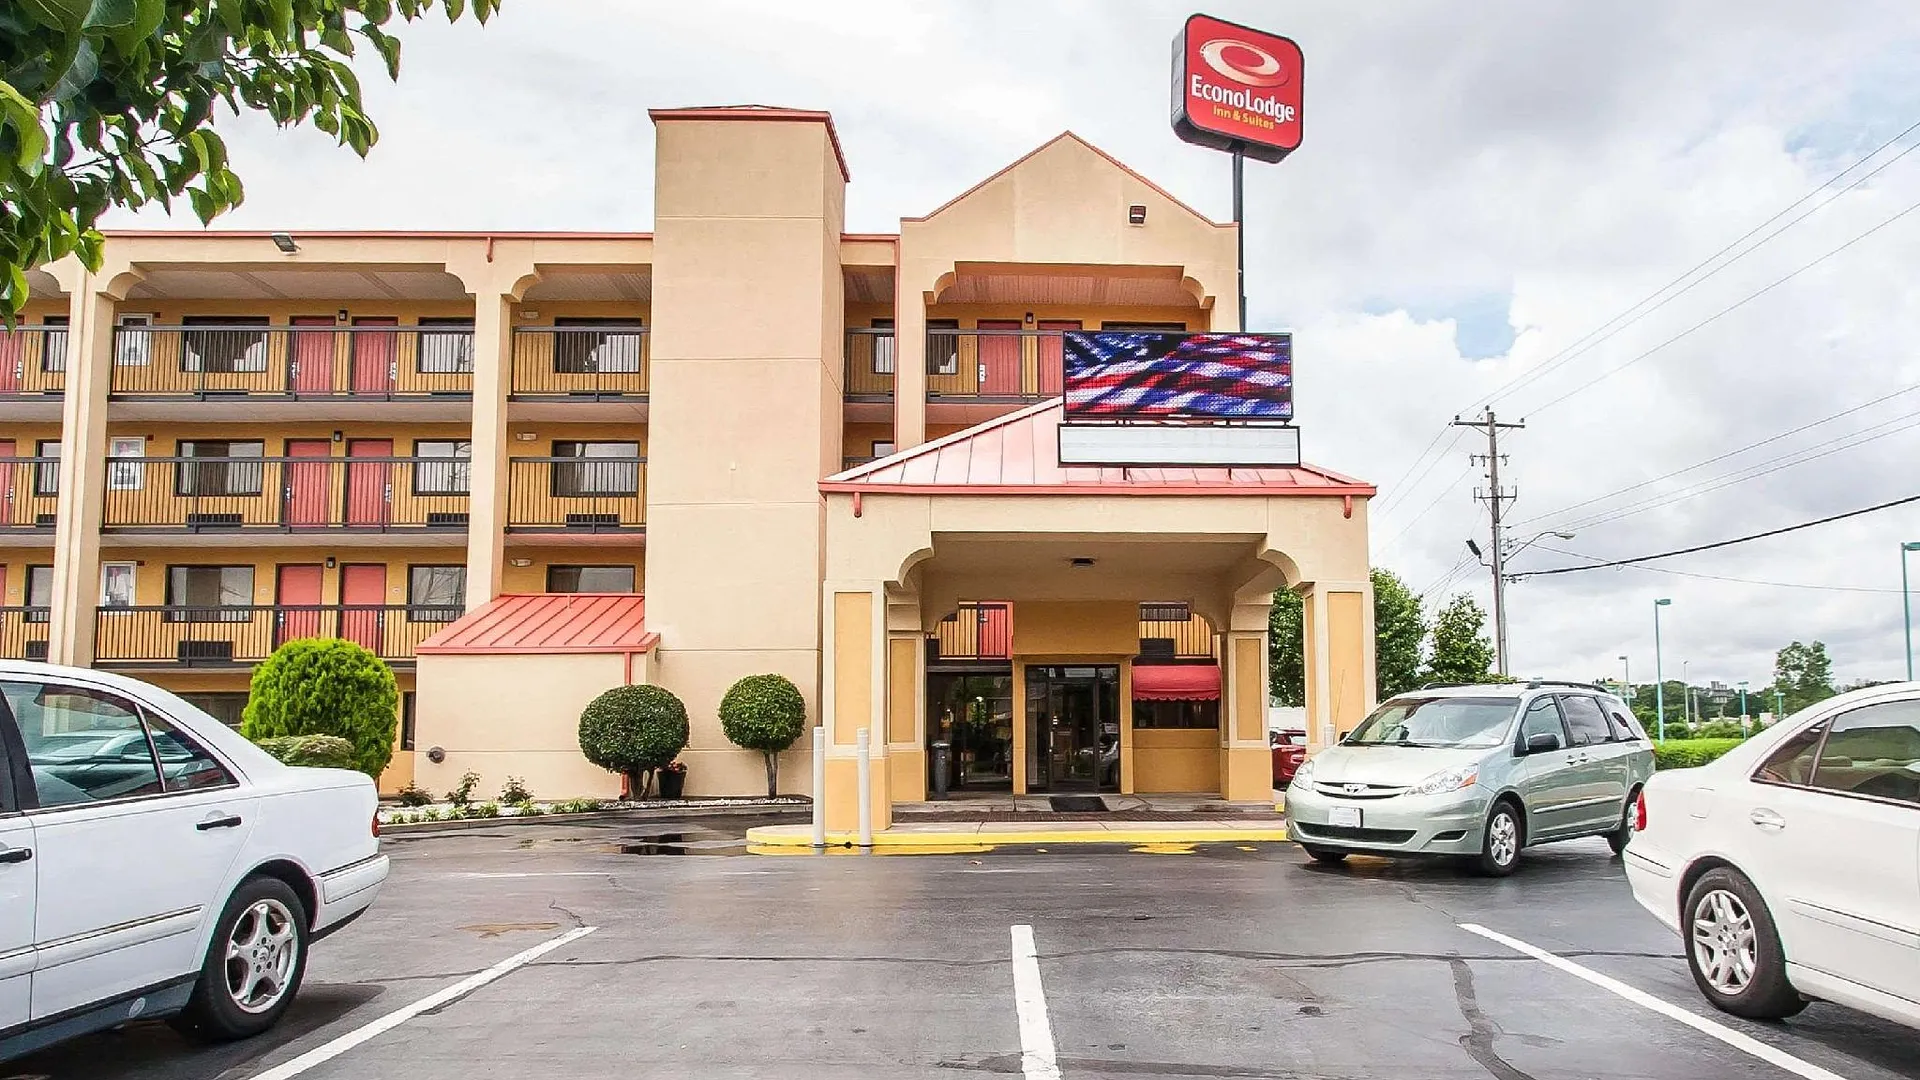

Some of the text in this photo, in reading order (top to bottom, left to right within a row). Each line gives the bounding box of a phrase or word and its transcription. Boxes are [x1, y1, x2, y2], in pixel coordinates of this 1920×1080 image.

[1191, 74, 1295, 123] EconoLodge
[1213, 105, 1275, 130] Inn & Suites
